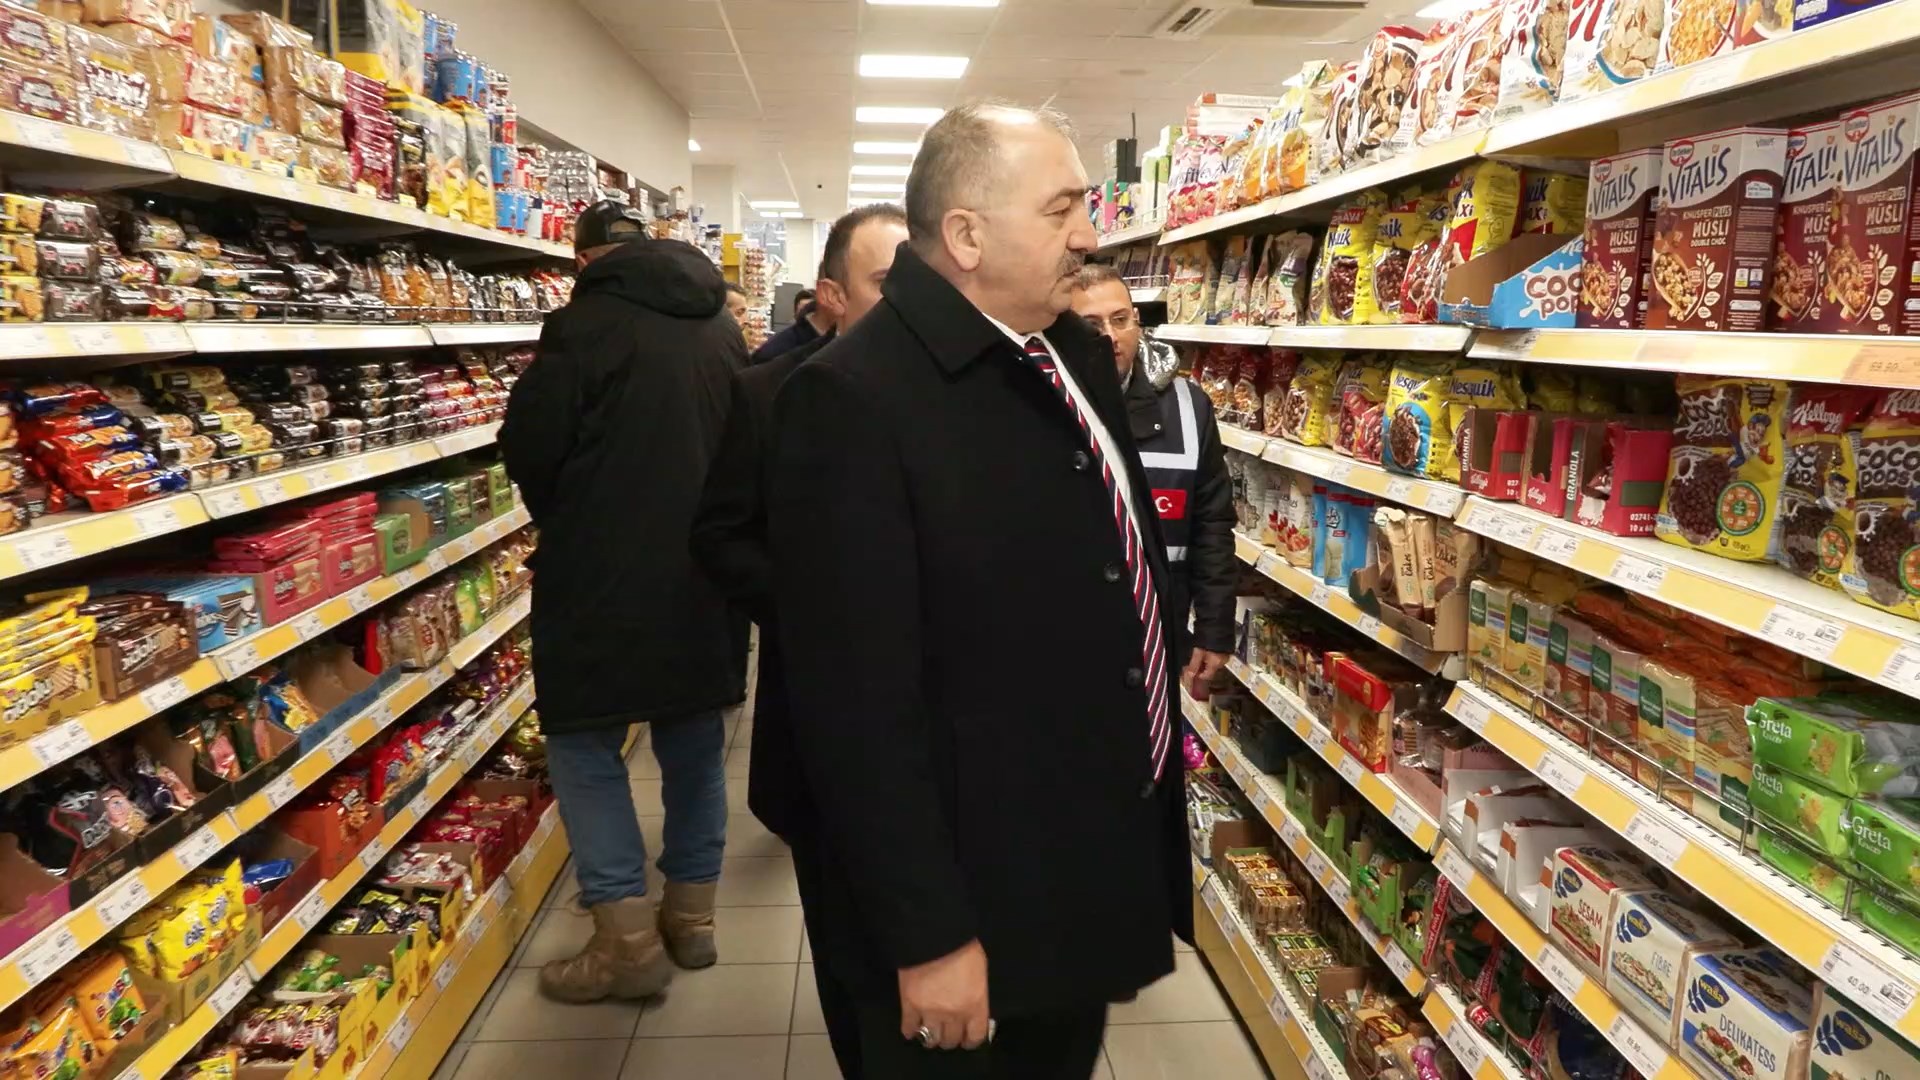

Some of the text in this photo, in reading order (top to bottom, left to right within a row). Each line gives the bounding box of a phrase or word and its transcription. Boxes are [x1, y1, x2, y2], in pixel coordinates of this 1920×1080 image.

[1845, 117, 1906, 186] VITALIS
[1668, 147, 1731, 204] VITALIS
[1593, 166, 1637, 216] VITALIS
[1683, 205, 1732, 220] KNUSPER PLUS
[1803, 214, 1831, 234] MÜS
[1866, 203, 1903, 225] MÜSLI
[1610, 230, 1637, 246] MÜSLI
[1693, 218, 1728, 236] MÜSLI
[1691, 236, 1727, 247] DOUBLE CHOC
[1449, 376, 1497, 399] Nesquik
[1792, 400, 1843, 432] Kellogg
[1462, 427, 1470, 471] GRANOLA
[1859, 445, 1920, 471] COCO
[1567, 450, 1580, 501] GRANOLA
[1759, 712, 1792, 738] Greta
[1752, 764, 1783, 794] Greta
[1852, 816, 1892, 851] Greta
[1578, 899, 1603, 931] SESAM
[1651, 951, 1672, 978] FIBRE
[1699, 980, 1725, 1004] wasa
[1719, 1014, 1777, 1073] DELIKATESS
